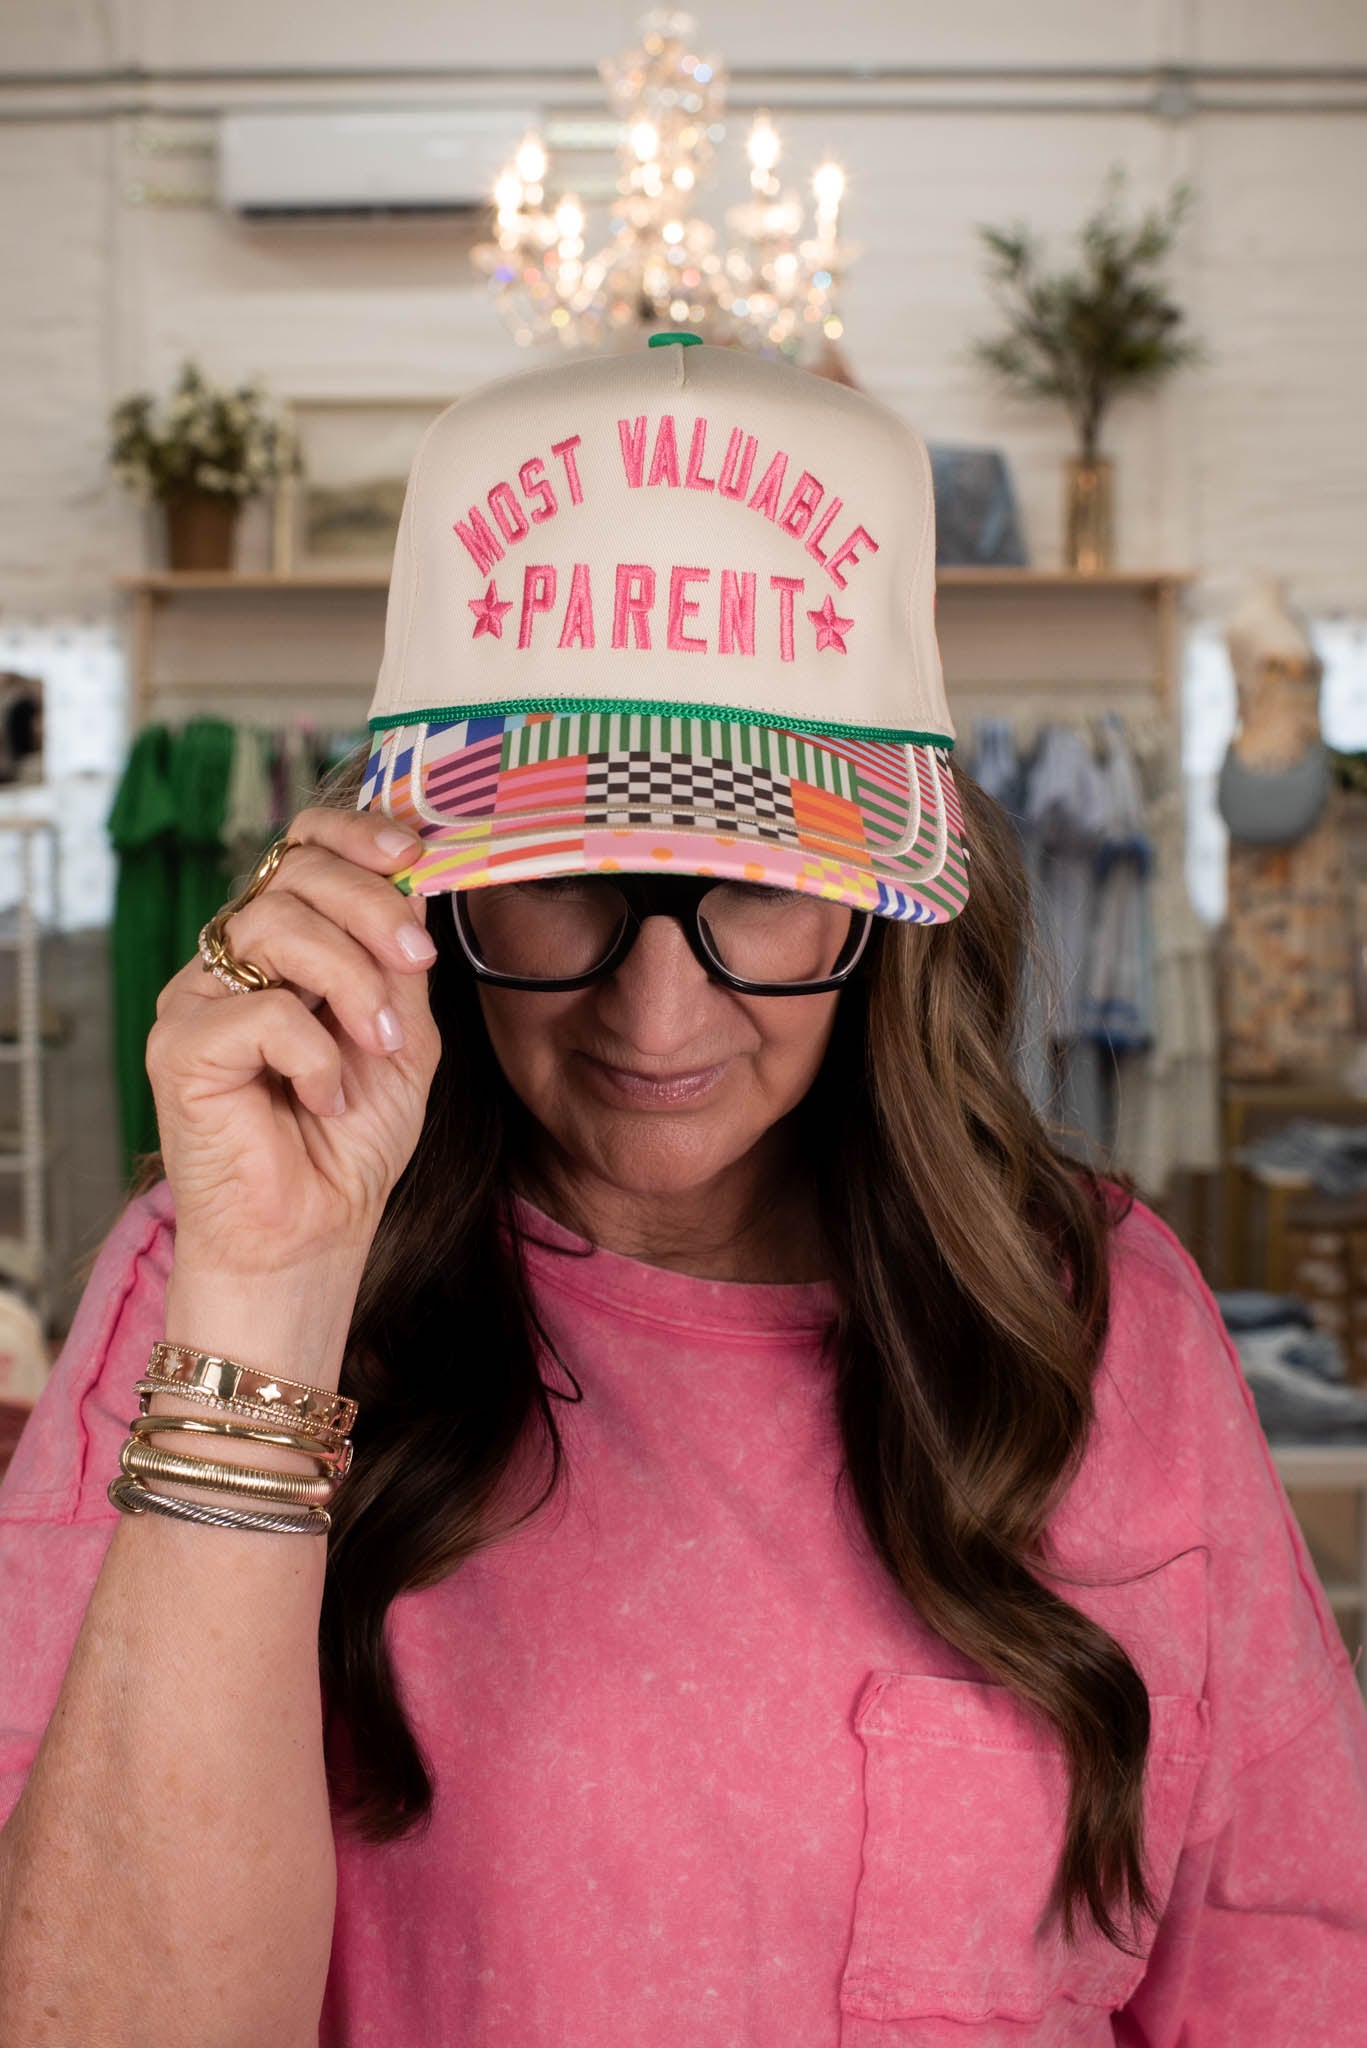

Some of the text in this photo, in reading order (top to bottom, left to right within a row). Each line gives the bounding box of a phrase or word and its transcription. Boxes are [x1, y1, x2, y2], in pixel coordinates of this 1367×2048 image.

[453, 415, 879, 590] MOST VALUABLE
[517, 564, 805, 662] PARENT
